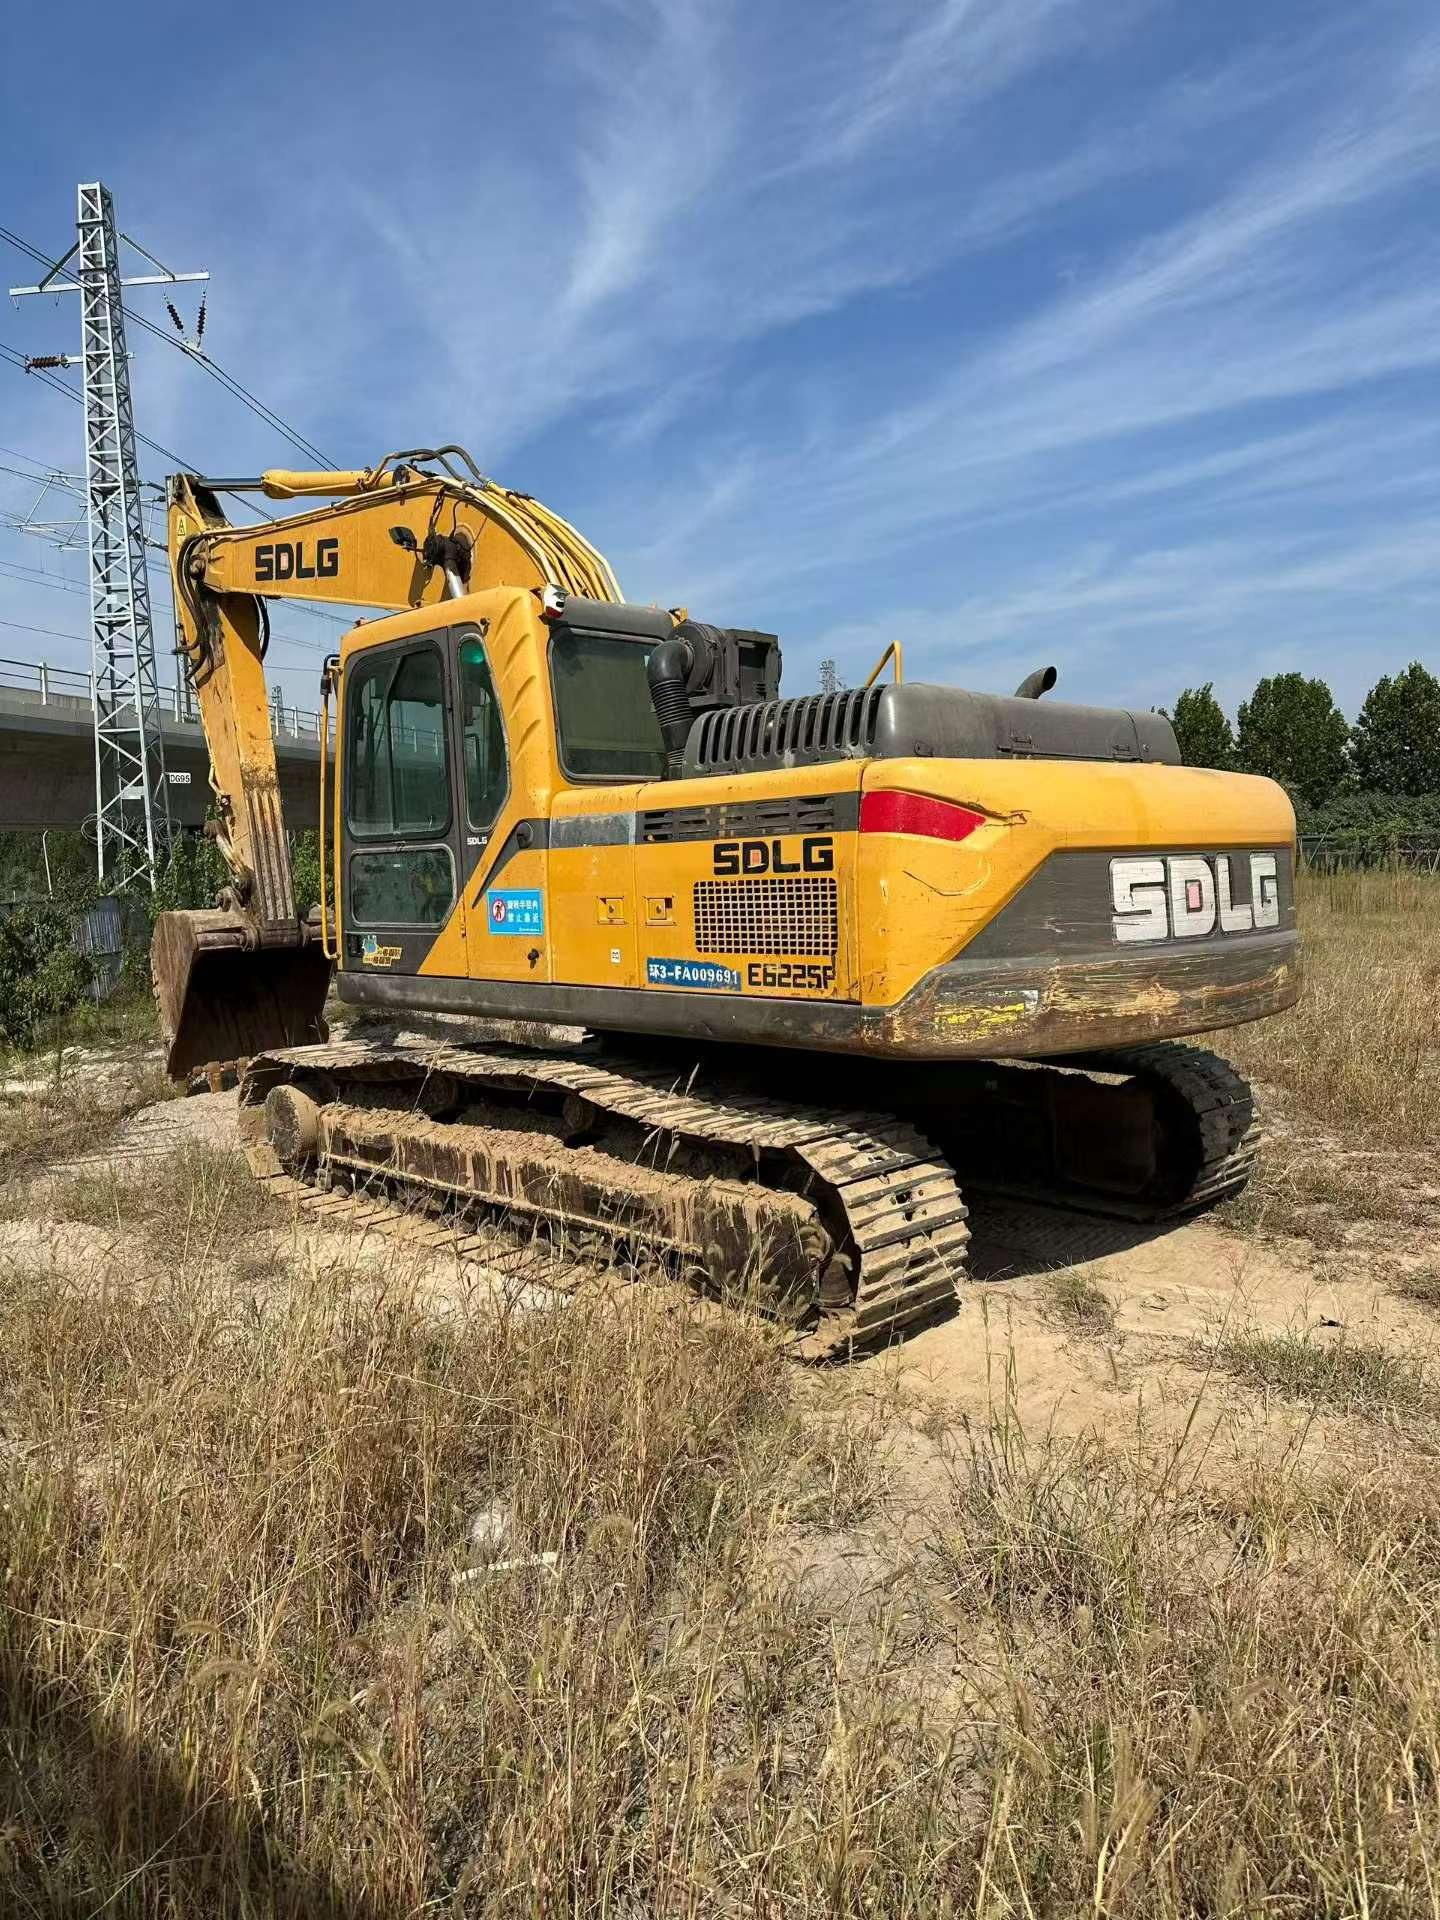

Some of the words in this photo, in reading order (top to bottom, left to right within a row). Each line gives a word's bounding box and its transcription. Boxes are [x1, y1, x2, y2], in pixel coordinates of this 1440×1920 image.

[255, 537, 338, 581] SDLG
[466, 836, 488, 846] SDLG
[713, 836, 834, 876] SDLG
[1110, 852, 1279, 943] SDLG
[649, 964, 738, 985] 环3-FA009691
